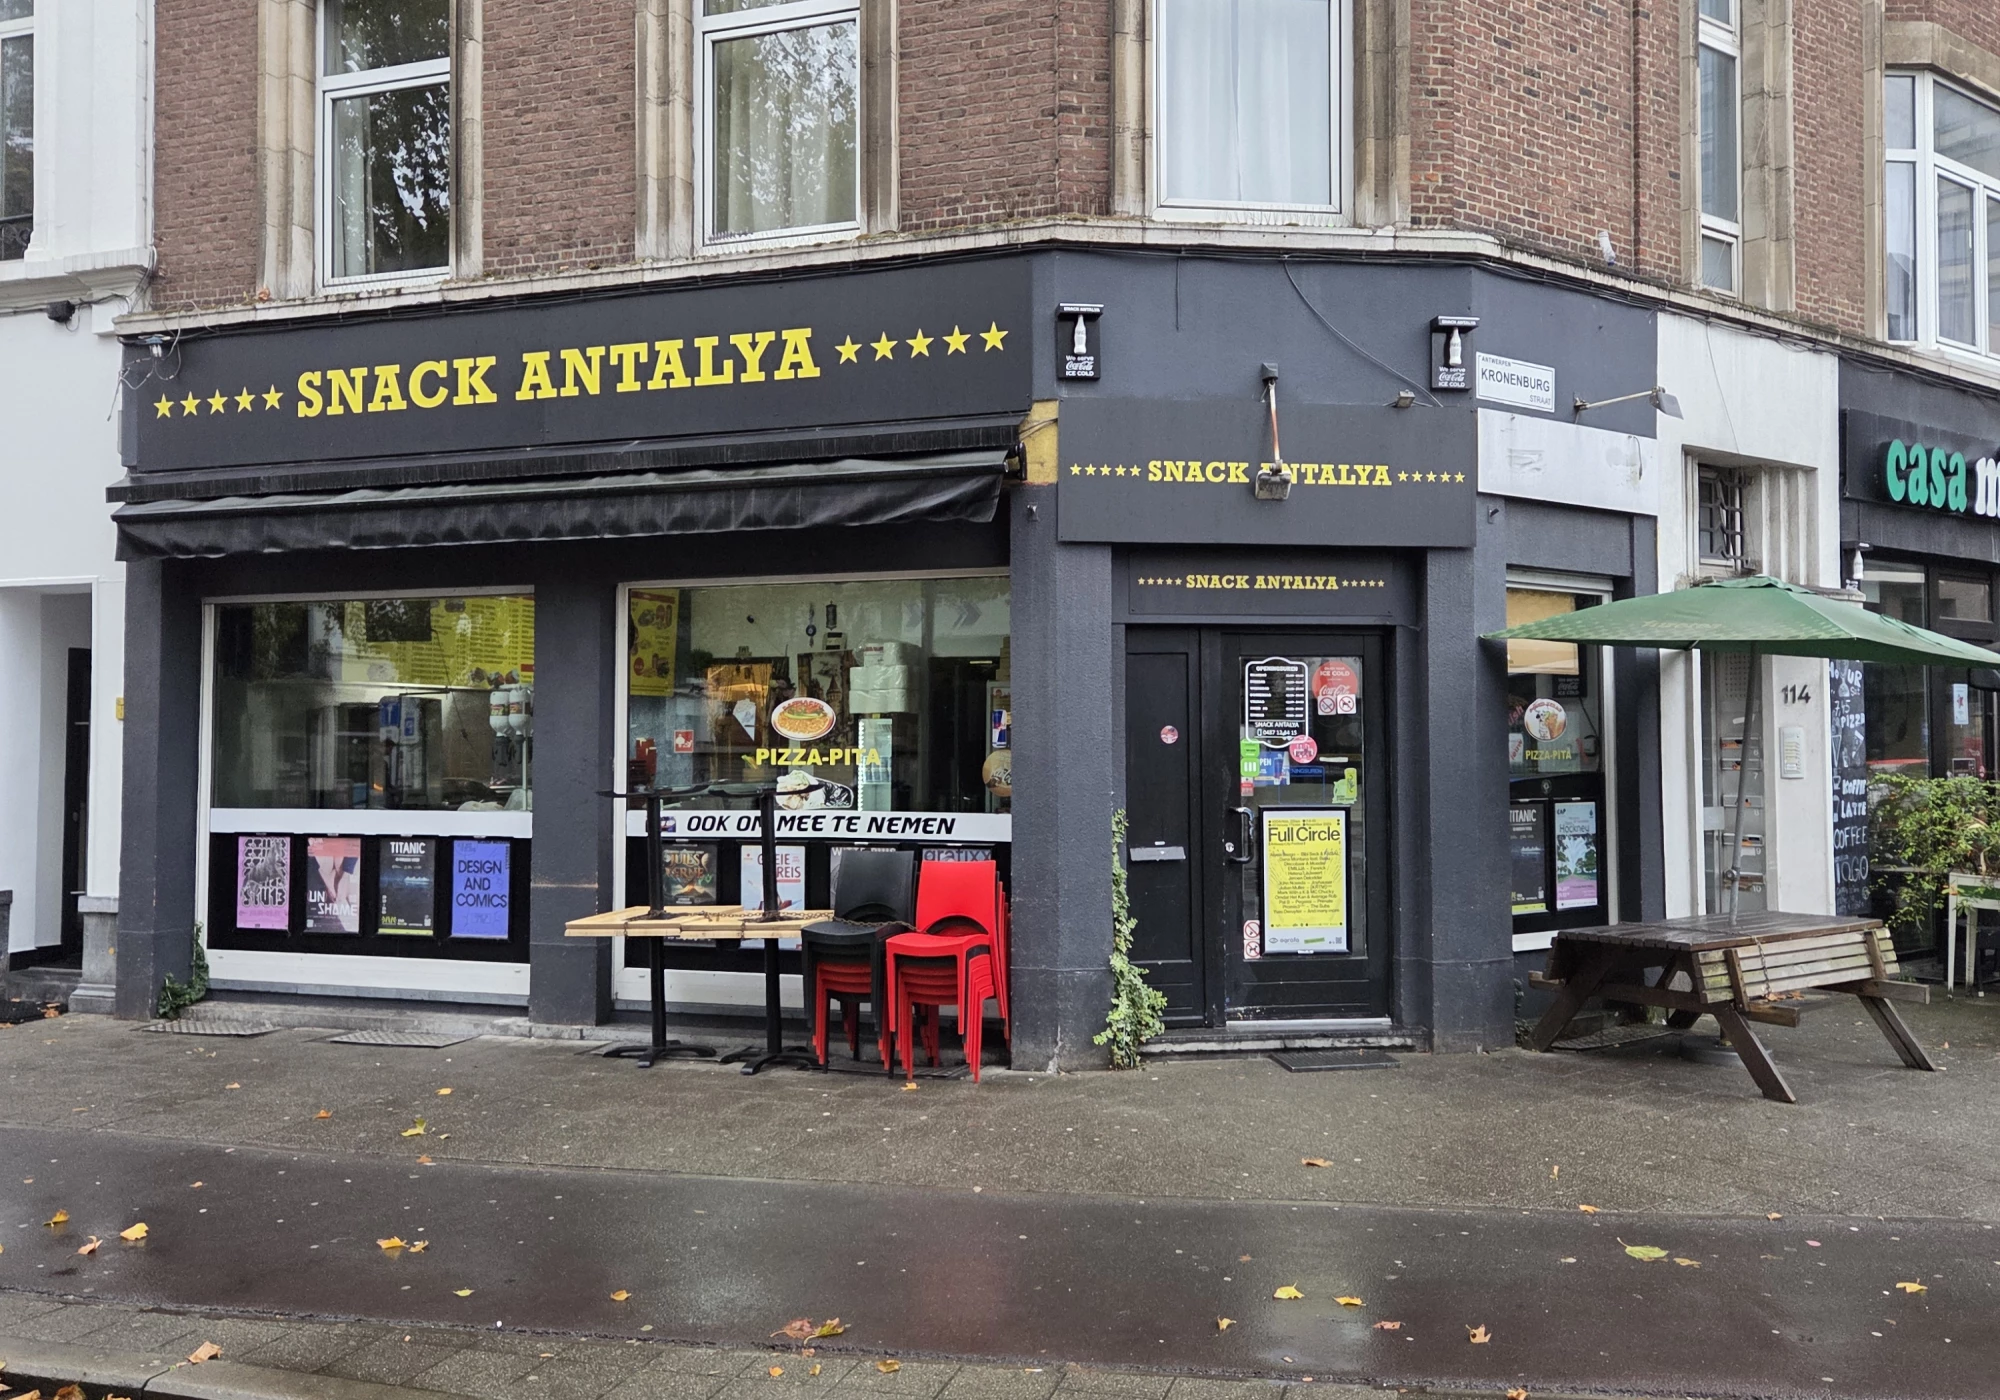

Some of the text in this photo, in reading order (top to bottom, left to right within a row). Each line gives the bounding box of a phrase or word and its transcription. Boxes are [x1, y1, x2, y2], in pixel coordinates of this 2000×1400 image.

[1482, 355, 1511, 367] ANTWERPEN
[298, 327, 821, 418] SNACK ANTALYA
[1481, 367, 1550, 392] KRONENBURG
[1529, 394, 1551, 406] STRAAT
[1148, 460, 1392, 486] SNACK NTALYA
[1886, 438, 1967, 513] Casa
[1186, 574, 1339, 590] SNACK ANTALYA
[1781, 684, 1811, 704] 114
[756, 748, 880, 766] PIZZA-PITA
[1259, 757, 1271, 766] PEN
[1525, 750, 1572, 760] PIZZA-PITA
[1510, 809, 1536, 822] TITANIC
[1841, 800, 1866, 819] LATTE
[687, 816, 731, 832] OOK
[777, 816, 826, 832] MEE
[832, 816, 861, 832] TE
[867, 816, 956, 834] NEMEN
[1560, 824, 1590, 833] Hockney
[1268, 826, 1340, 842] Full Circle
[390, 842, 426, 854] TITANIC
[458, 860, 502, 874] DESIGN
[464, 877, 491, 890] AND
[309, 891, 325, 902] UN
[456, 893, 507, 908] COMICS
